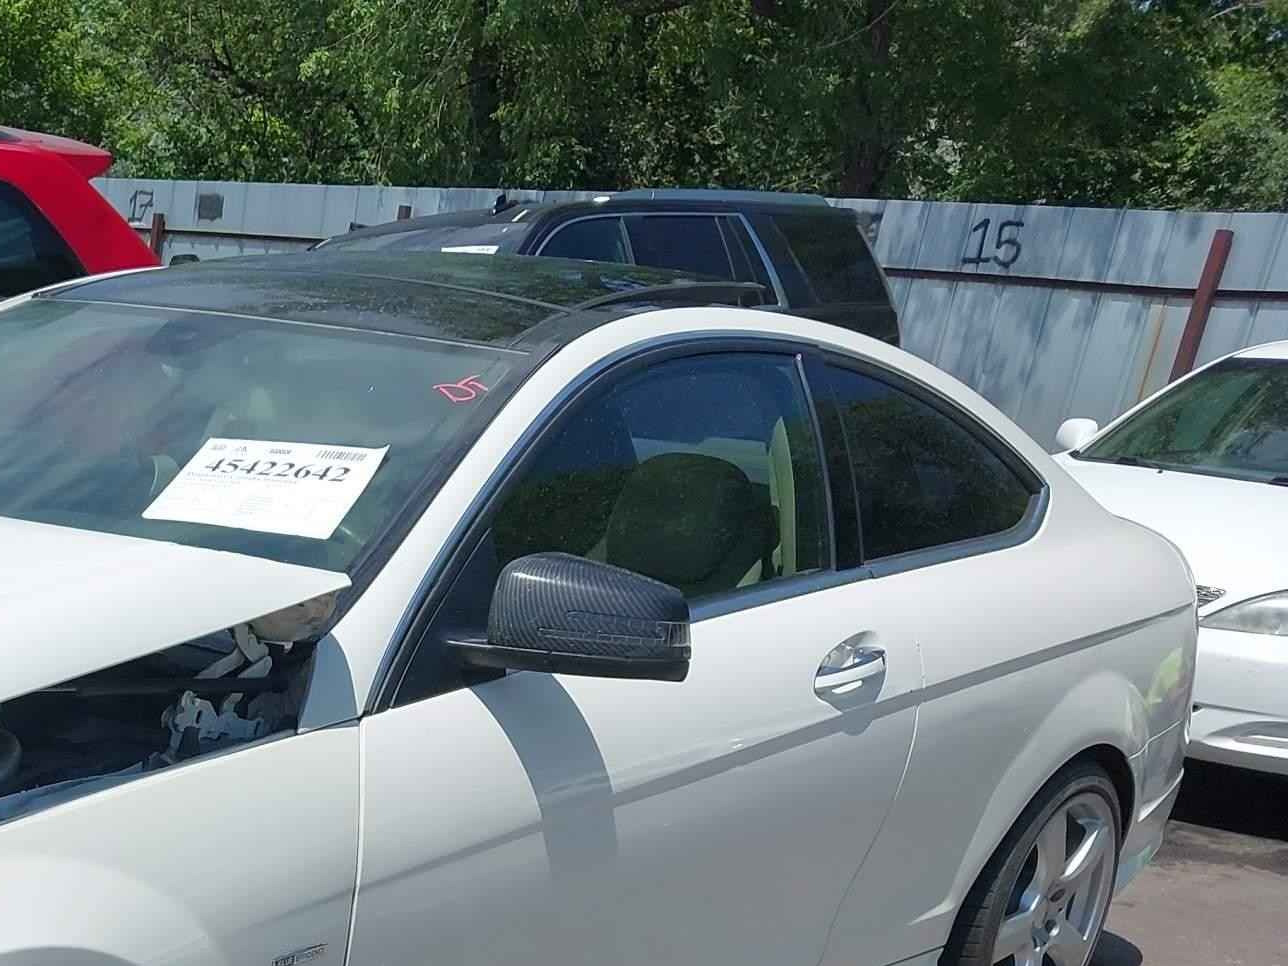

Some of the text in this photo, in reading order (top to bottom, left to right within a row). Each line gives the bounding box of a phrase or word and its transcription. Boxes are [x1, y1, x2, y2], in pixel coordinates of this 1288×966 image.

[127, 189, 154, 222] 17
[962, 217, 1025, 269] 15
[205, 457, 351, 482] 45422642
